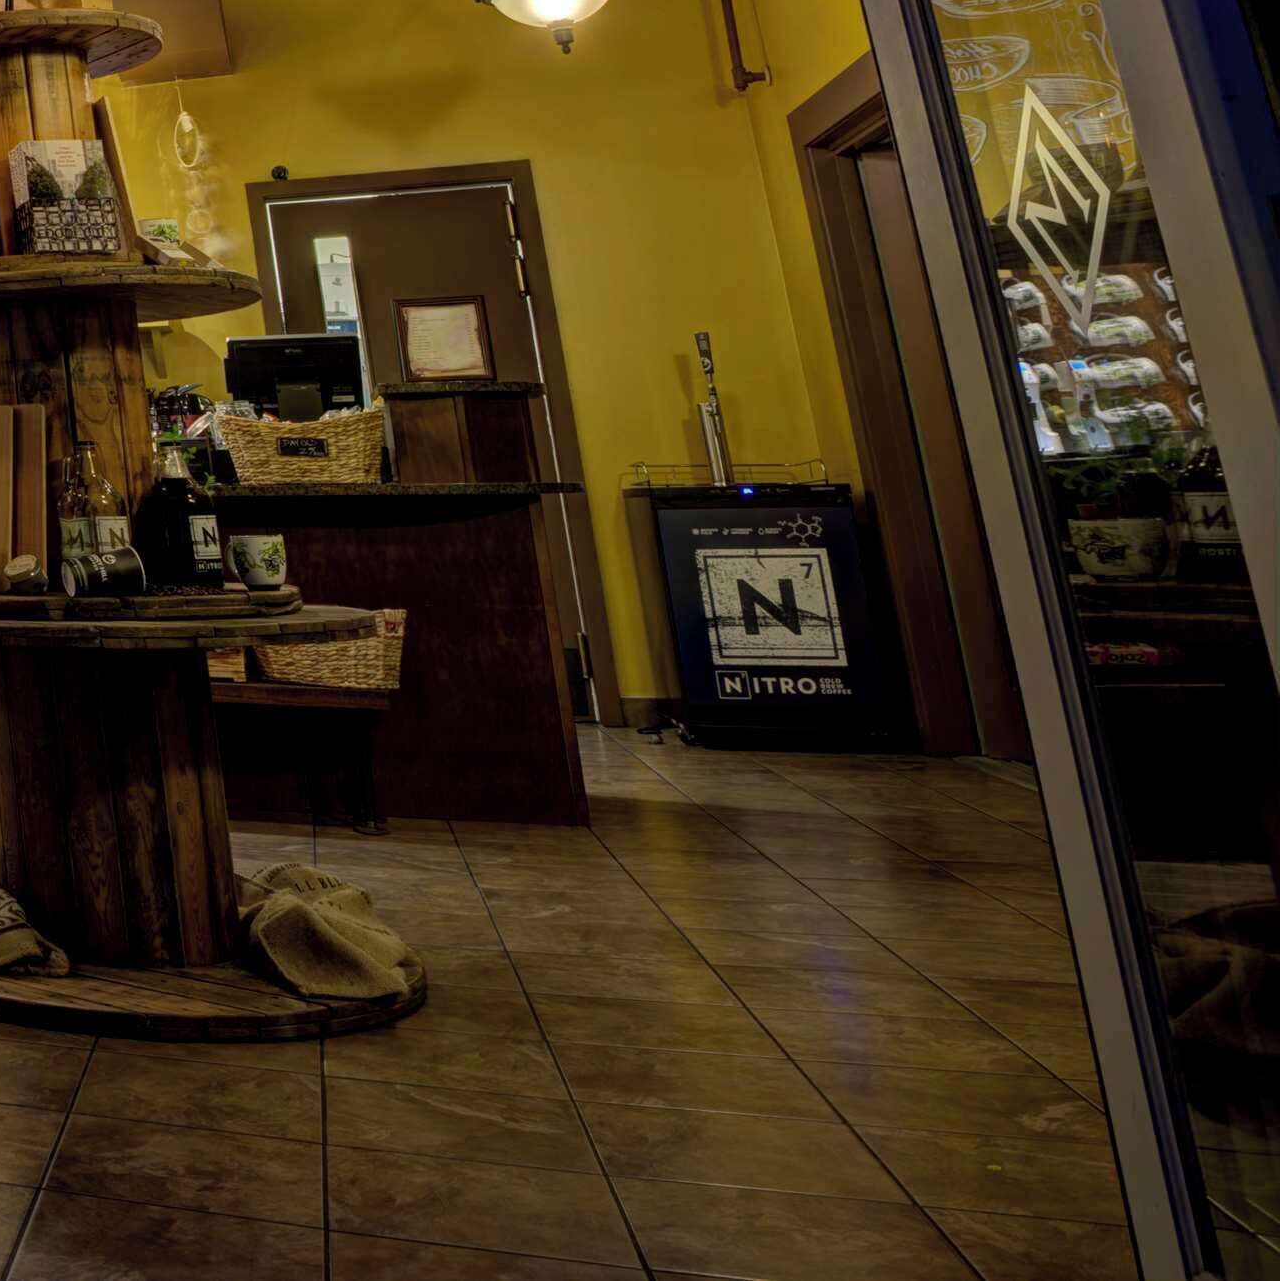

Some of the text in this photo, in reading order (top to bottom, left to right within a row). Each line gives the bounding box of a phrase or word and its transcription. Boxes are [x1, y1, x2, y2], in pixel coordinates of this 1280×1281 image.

[201, 526, 219, 549] N
[799, 563, 814, 579] 7
[736, 578, 802, 636] N
[724, 676, 817, 695] NITRO
